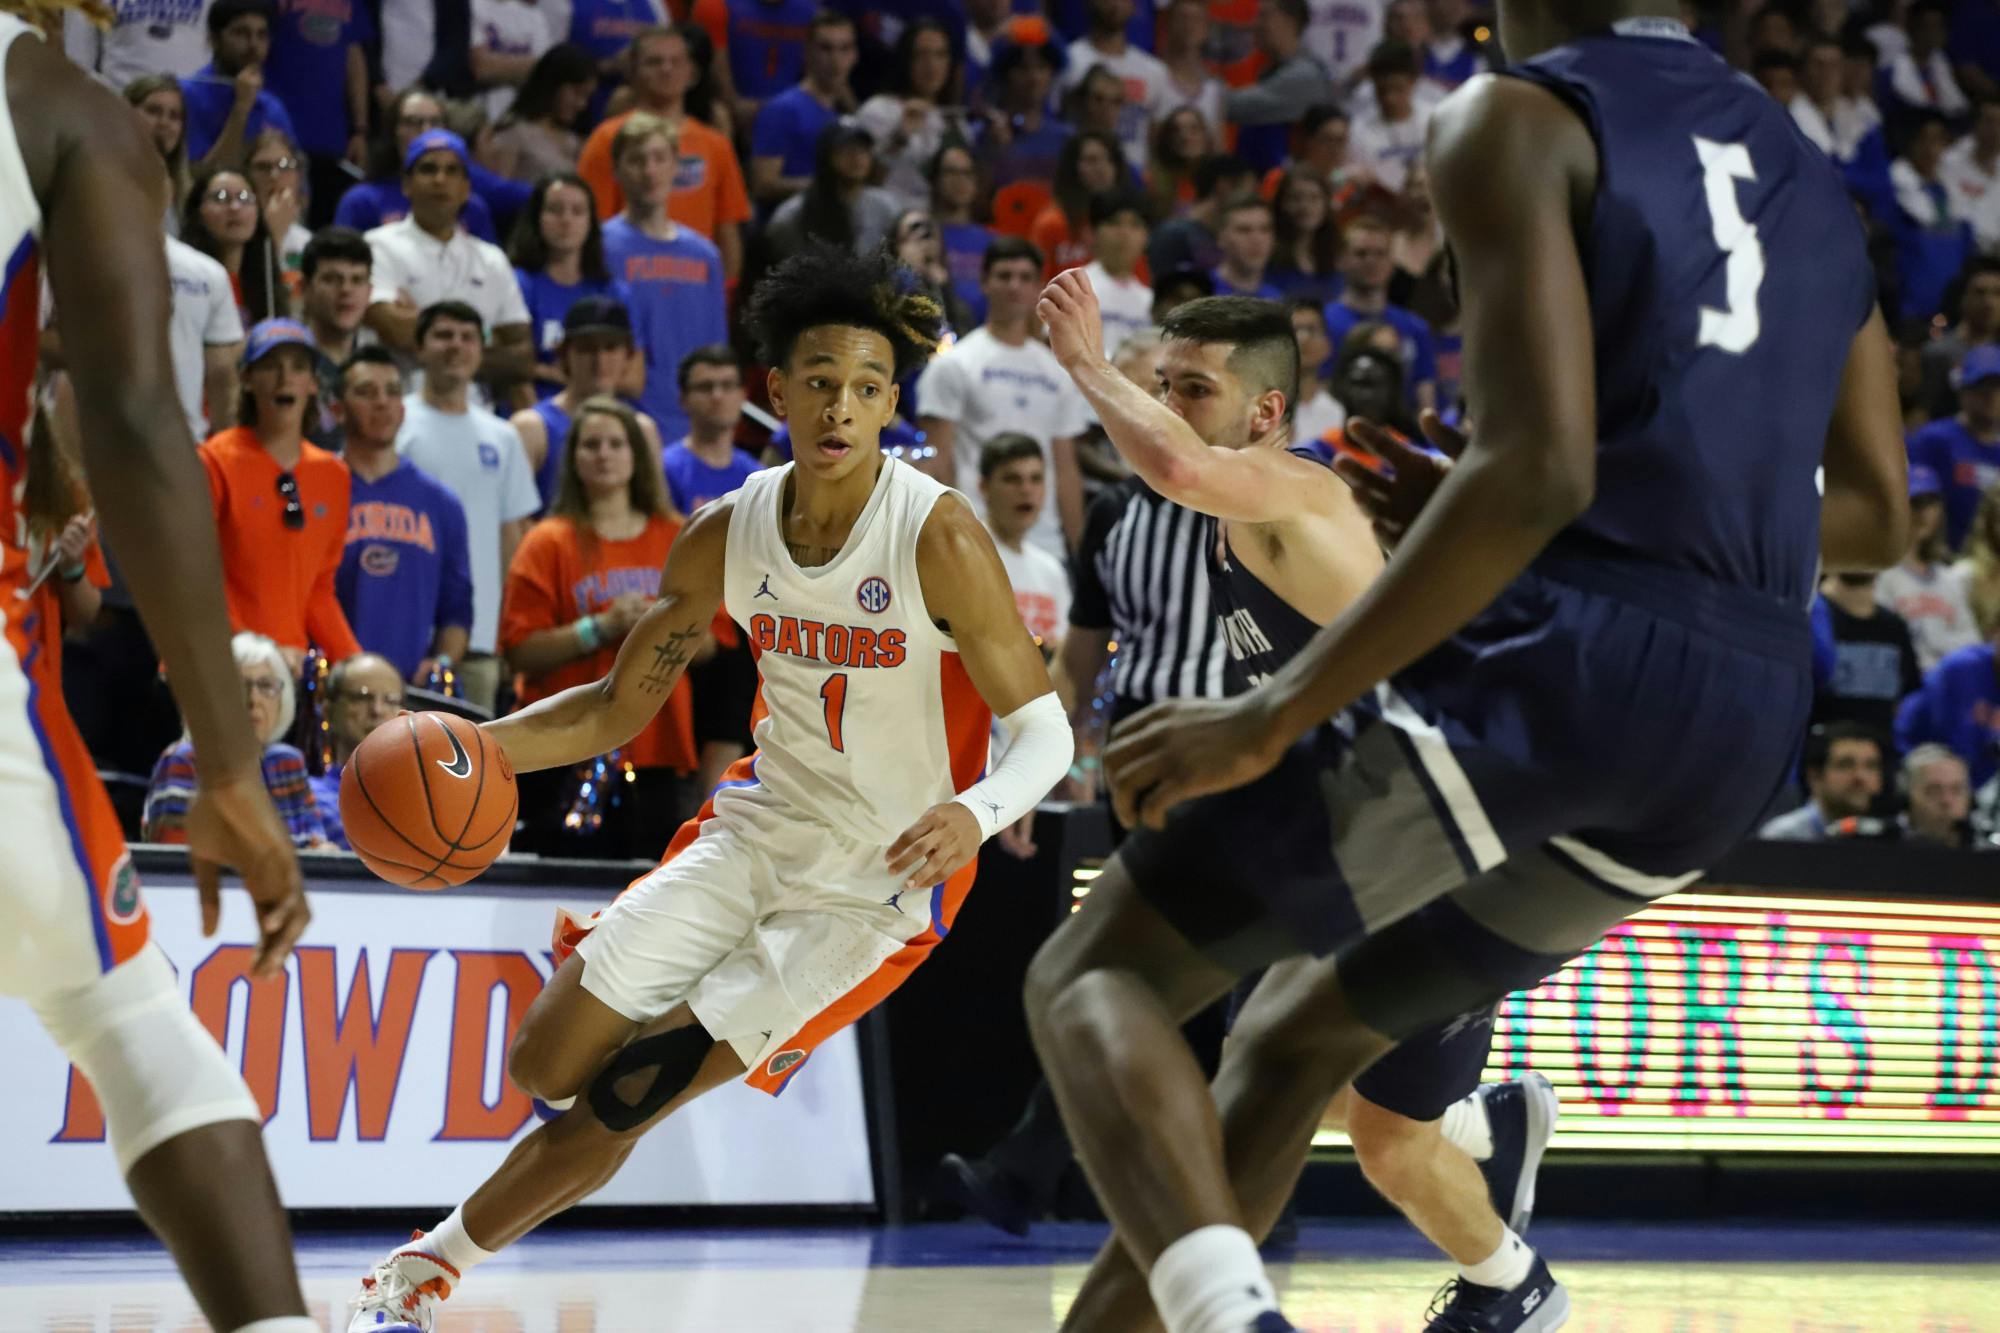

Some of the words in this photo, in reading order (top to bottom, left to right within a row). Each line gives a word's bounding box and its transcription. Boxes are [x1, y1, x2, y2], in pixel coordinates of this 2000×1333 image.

[1691, 135, 1765, 353] 5
[859, 578, 889, 613] SEC
[750, 613, 907, 668] GATORS
[819, 672, 847, 753] 1
[47, 944, 557, 1143] OWD
